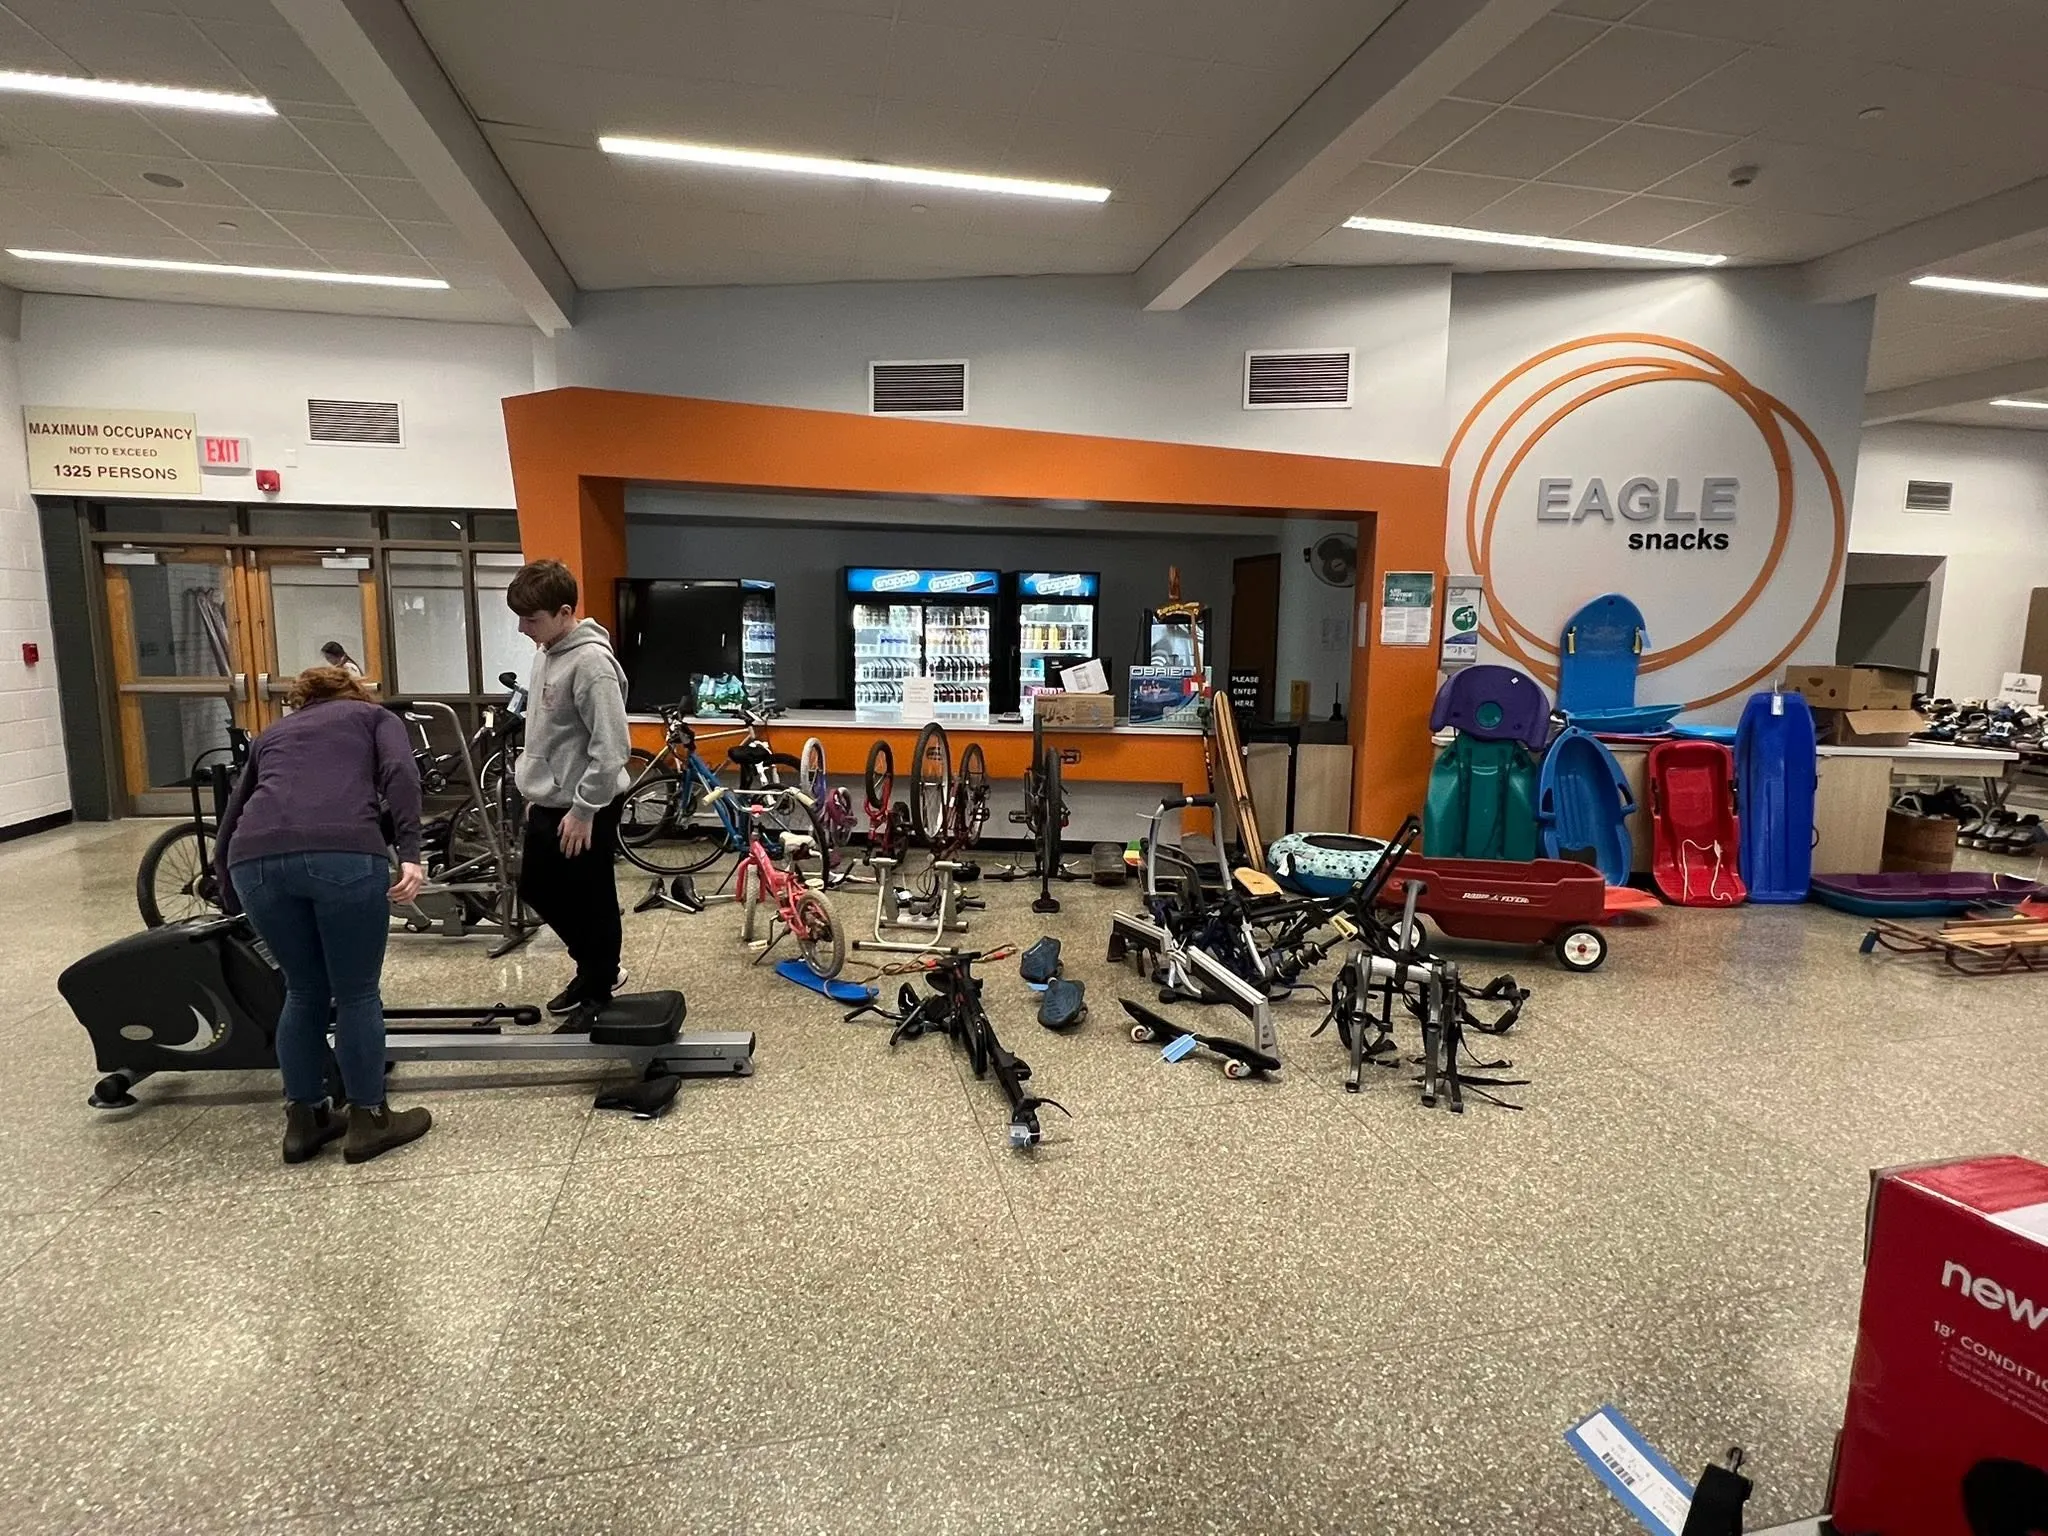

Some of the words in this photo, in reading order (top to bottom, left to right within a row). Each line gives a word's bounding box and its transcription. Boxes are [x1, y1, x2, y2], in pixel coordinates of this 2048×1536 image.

[28, 422, 99, 437] MAXIMUM
[103, 426, 193, 440] OCCUPANCY
[69, 446, 92, 455] NOT
[95, 447, 109, 456] TO
[112, 448, 158, 457] EXCEED
[205, 438, 240, 463] EXIT
[53, 465, 92, 477] 1325
[97, 466, 178, 480] PERSONS
[1537, 477, 1740, 521] EAGLE
[1628, 528, 1729, 550] snacks
[1500, 895, 1529, 903] FLYER
[1934, 1320, 1956, 1337] 18'
